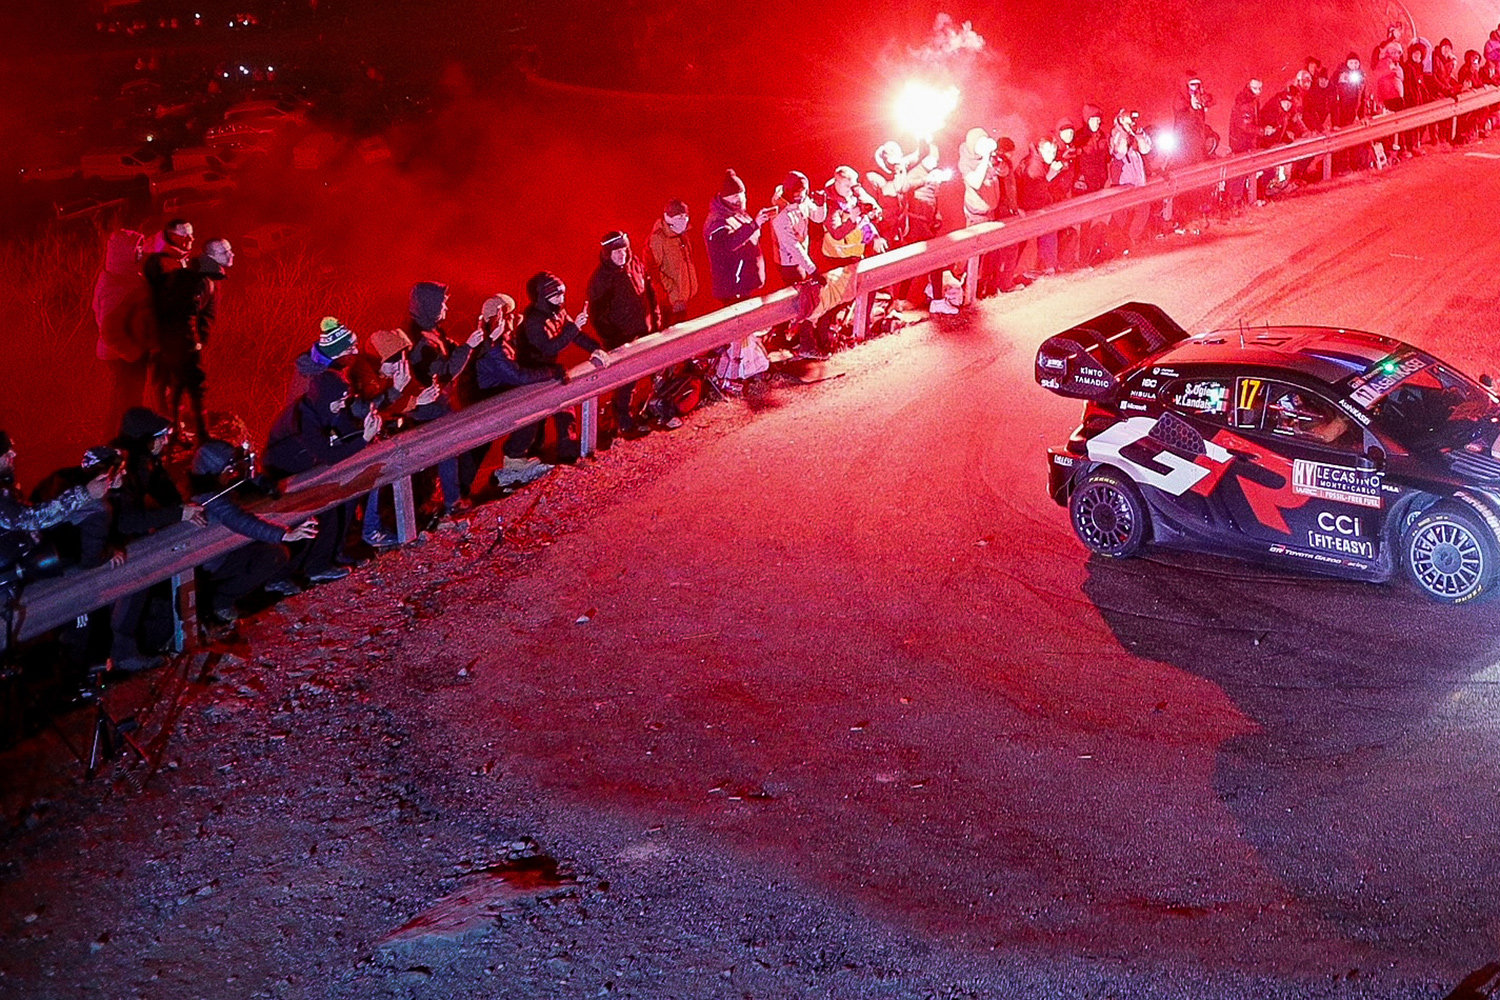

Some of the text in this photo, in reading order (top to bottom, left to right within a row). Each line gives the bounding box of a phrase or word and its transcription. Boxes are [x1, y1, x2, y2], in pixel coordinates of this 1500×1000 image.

[1074, 375, 1109, 388] TAMADIC
[1241, 379, 1260, 410] 17
[1317, 466, 1330, 479] LE
[1285, 549, 1314, 559] TOYOTA
[1314, 554, 1342, 564] GAZOO
